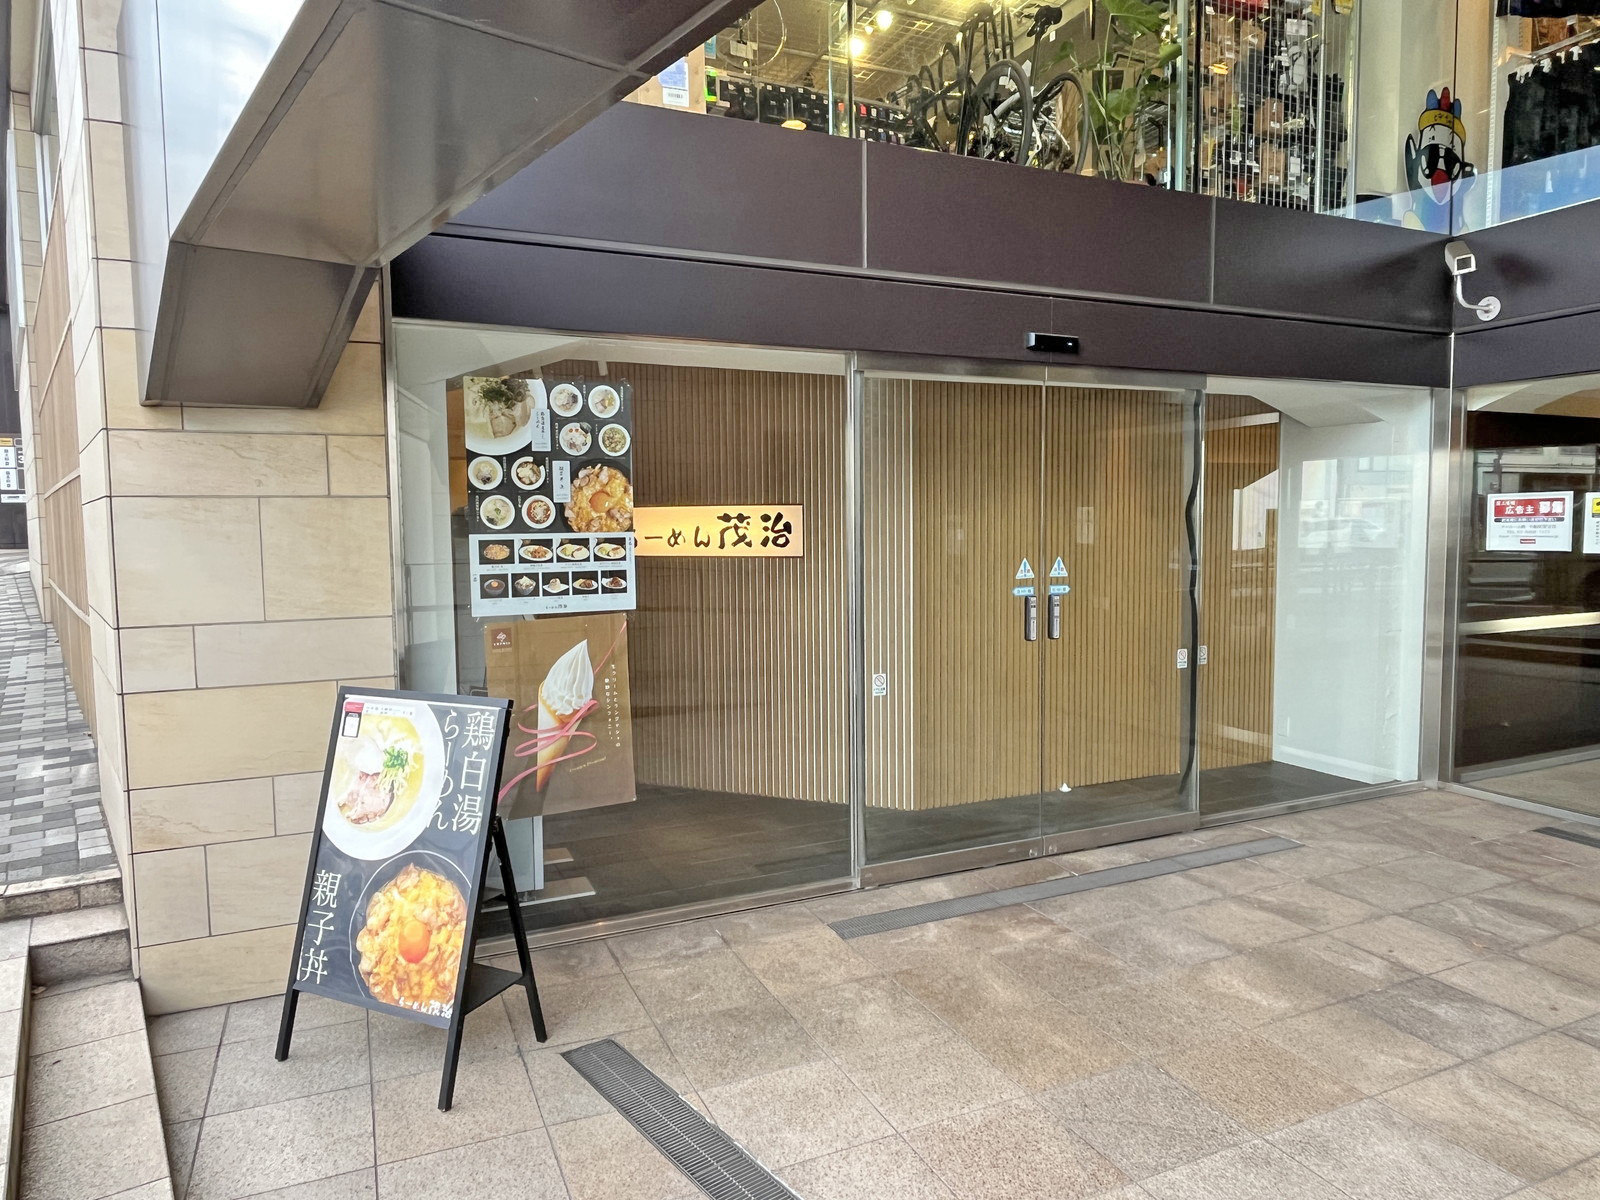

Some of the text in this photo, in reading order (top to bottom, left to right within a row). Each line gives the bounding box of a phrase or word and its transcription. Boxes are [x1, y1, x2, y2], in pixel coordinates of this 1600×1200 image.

[633, 511, 793, 550] ーめん茂治
[451, 711, 496, 836] 鶏白湯
[301, 869, 342, 985] 親子丼
